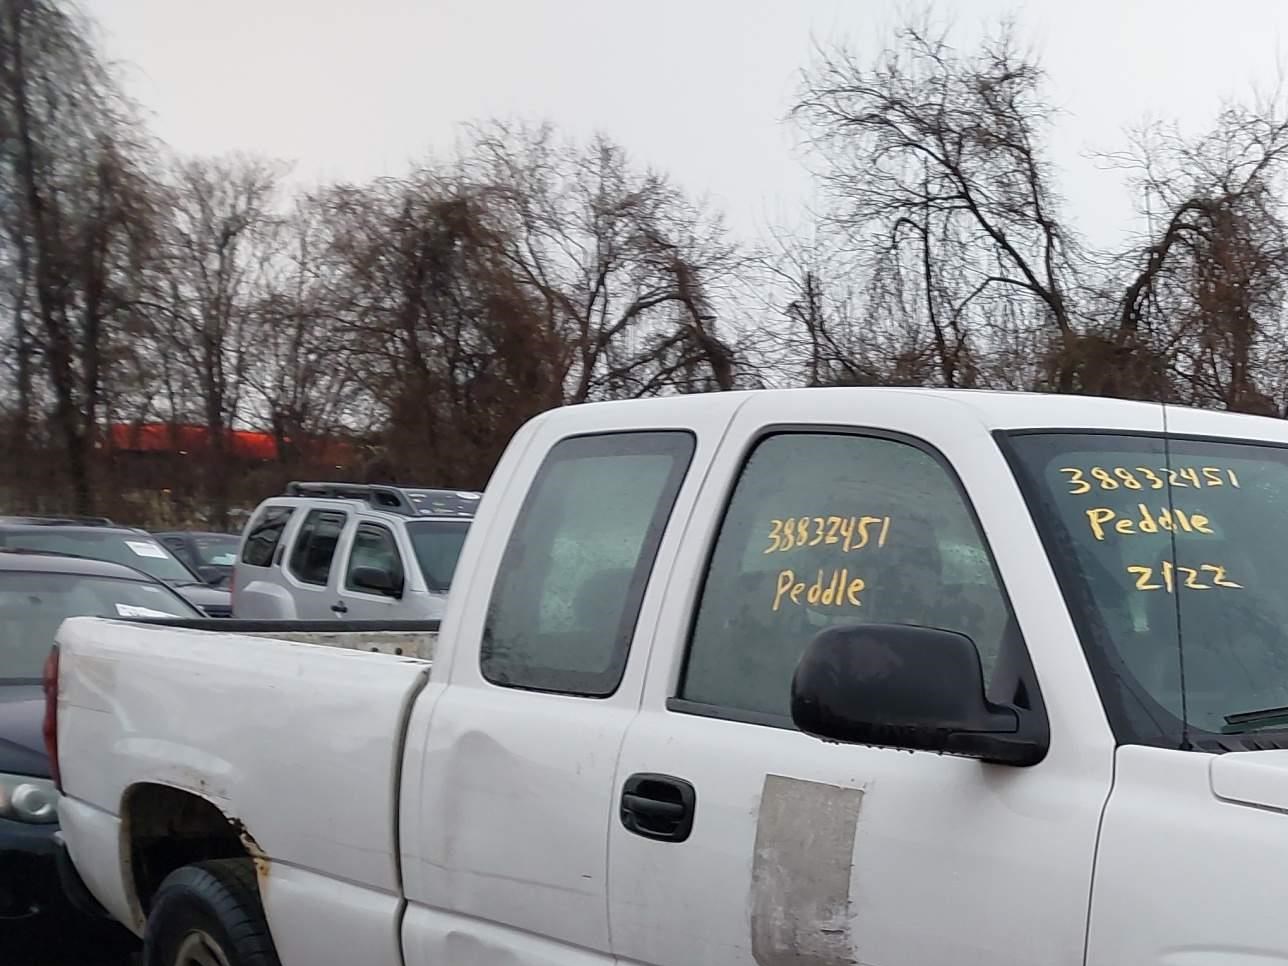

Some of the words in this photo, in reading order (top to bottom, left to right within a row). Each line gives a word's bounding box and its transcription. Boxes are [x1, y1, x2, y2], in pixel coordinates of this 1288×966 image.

[1060, 467, 1240, 494] 38832451
[763, 516, 890, 553] 38832451
[1086, 503, 1215, 541] Peddle
[772, 568, 865, 611] Peddle
